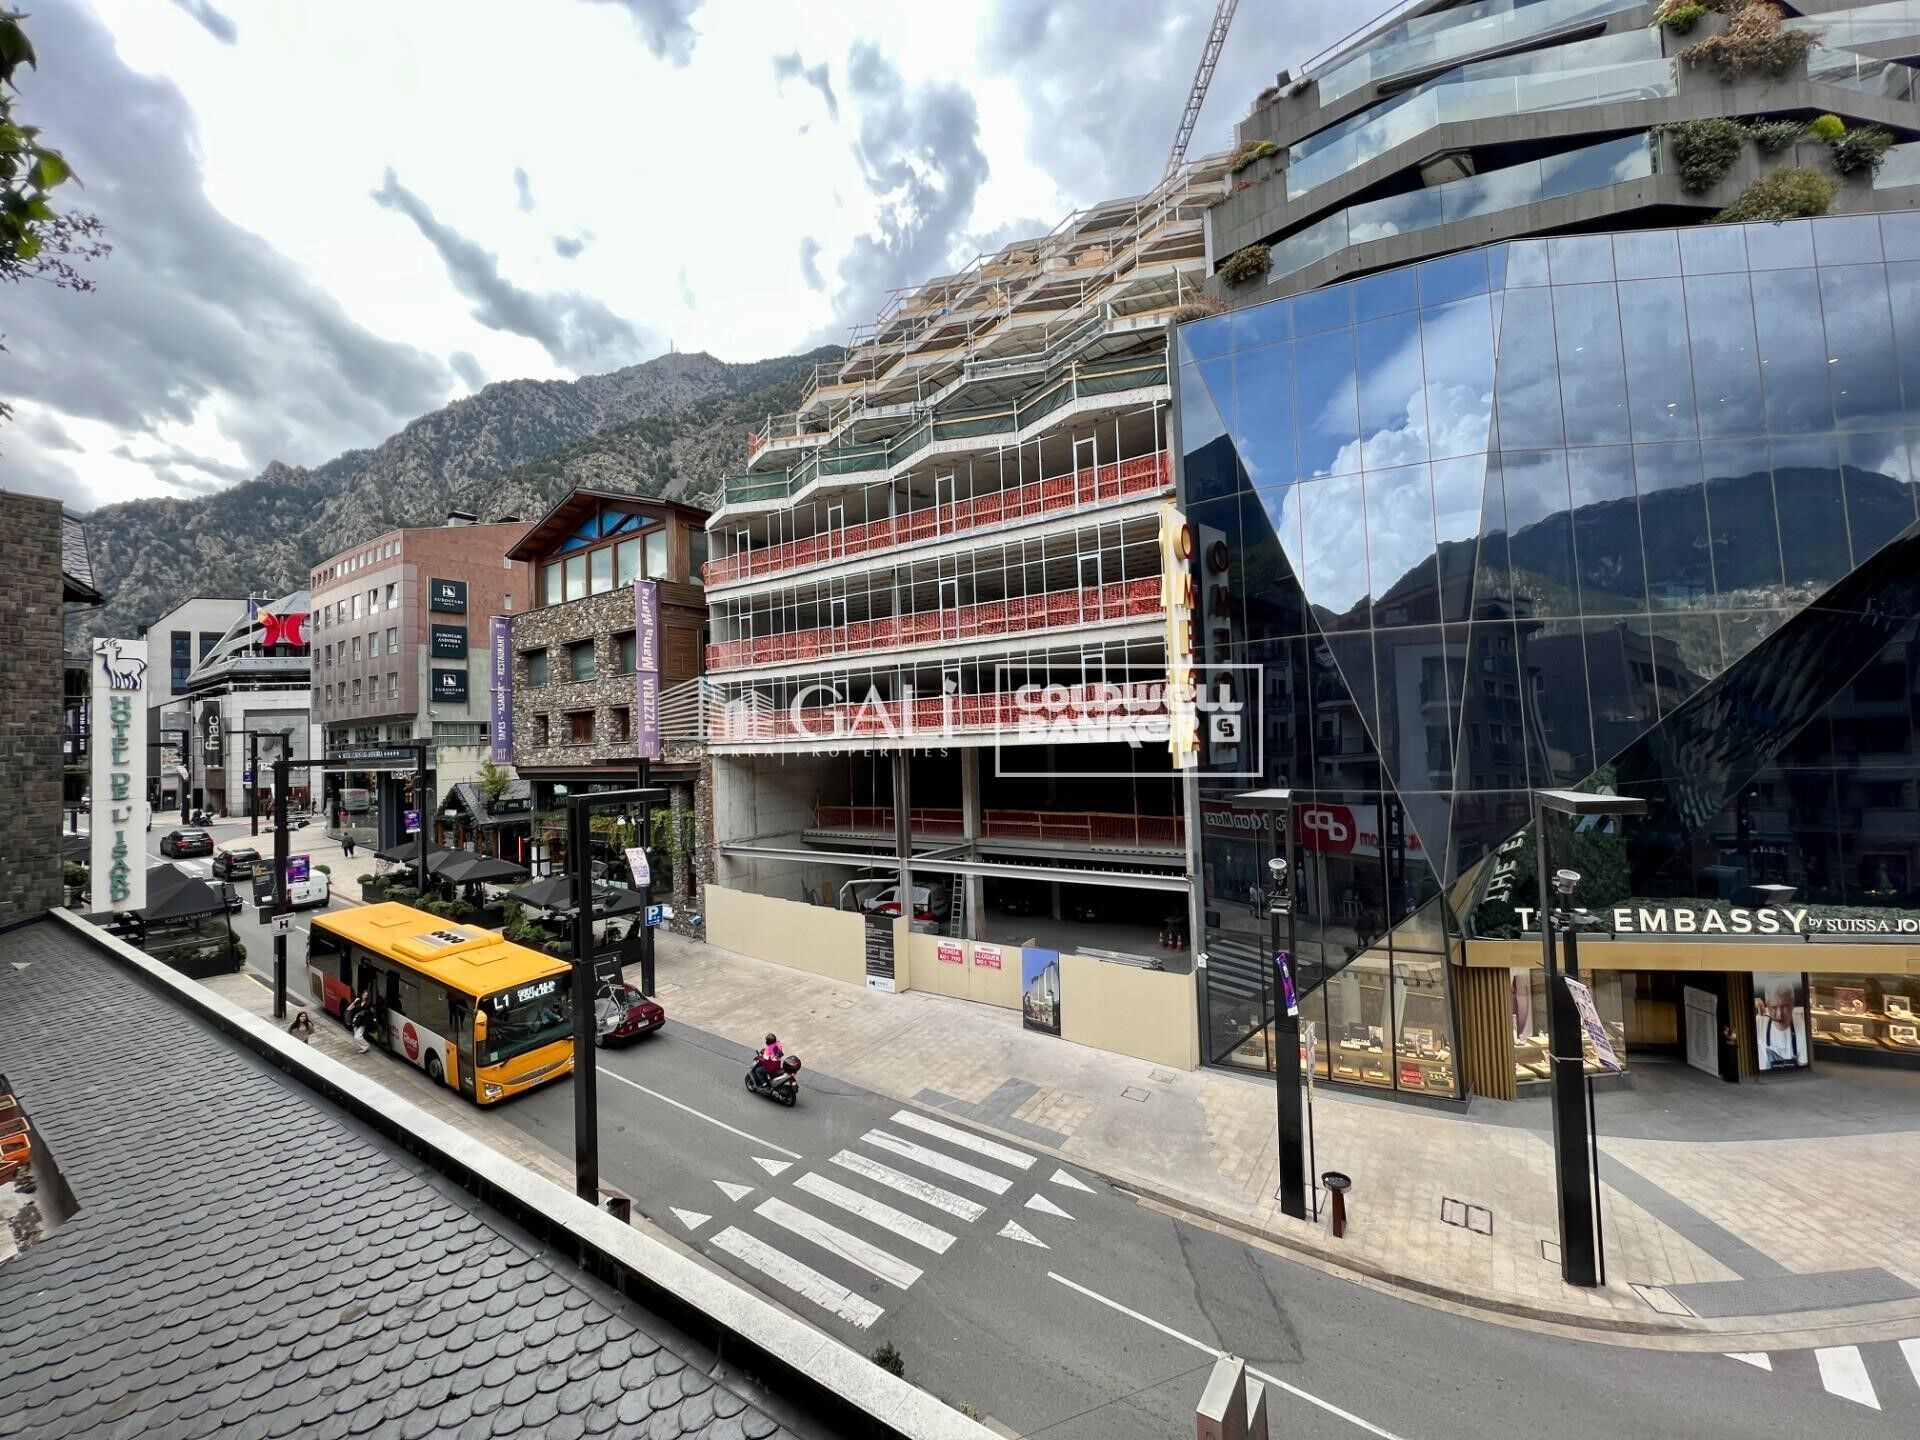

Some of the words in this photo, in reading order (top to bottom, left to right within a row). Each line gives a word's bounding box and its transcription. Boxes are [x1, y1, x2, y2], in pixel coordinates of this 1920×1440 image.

[641, 587, 654, 625] Maria
[497, 635, 505, 676] RESTAURANT
[641, 629, 654, 669] Mama
[643, 678, 656, 732] PIZZERIA
[109, 696, 131, 766] HOTEL
[204, 715, 220, 751] fnac
[498, 721, 506, 741] TAPES
[110, 773, 131, 801] DE
[280, 919, 288, 930] H
[648, 906, 659, 921] P
[1613, 908, 1808, 933] EMBASSY
[1808, 917, 1823, 928] by
[1826, 919, 1891, 932] SUISSA
[1894, 919, 1920, 932] JO
[493, 993, 510, 1010] L1
